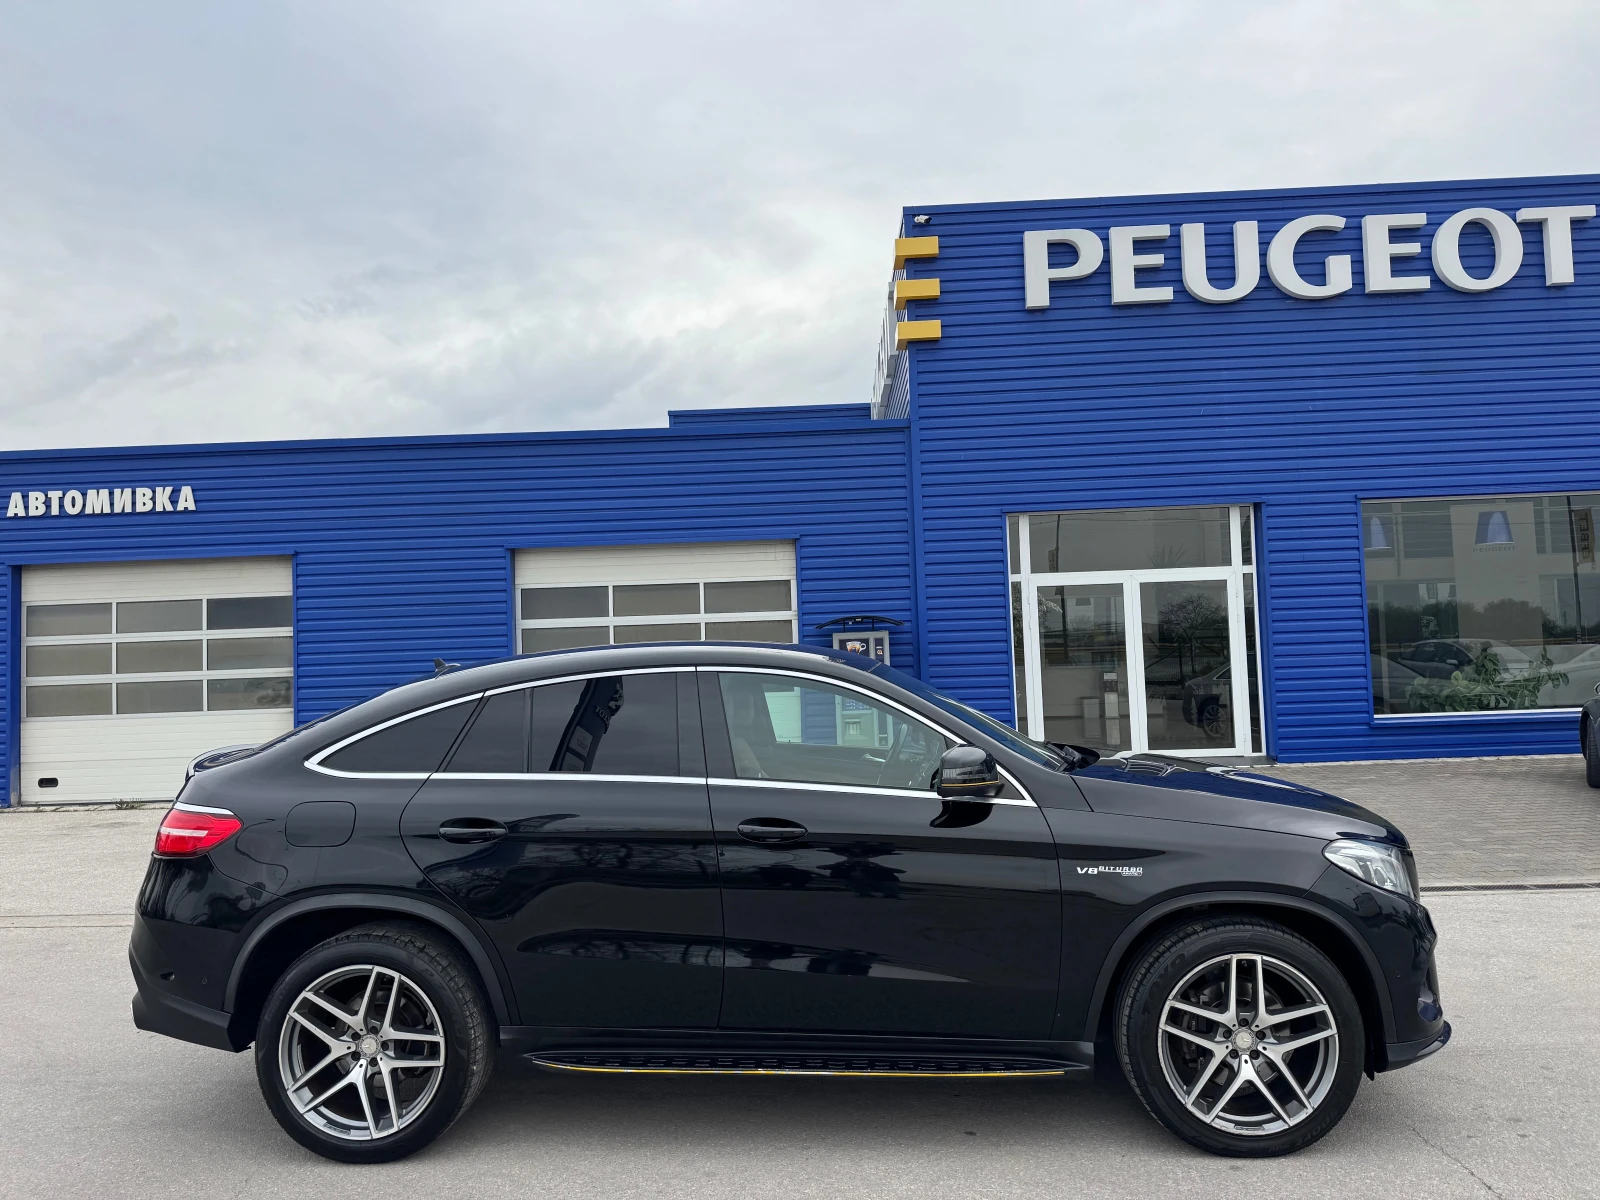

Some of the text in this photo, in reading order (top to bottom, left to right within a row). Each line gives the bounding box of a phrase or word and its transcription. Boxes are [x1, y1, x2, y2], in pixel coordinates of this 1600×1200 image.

[1022, 204, 1597, 310] PEUGEOT
[6, 485, 197, 517] АВТОМИВКА
[1472, 545, 1517, 553] PEUGEOT
[1076, 865, 1143, 875] V8 BITURBO
